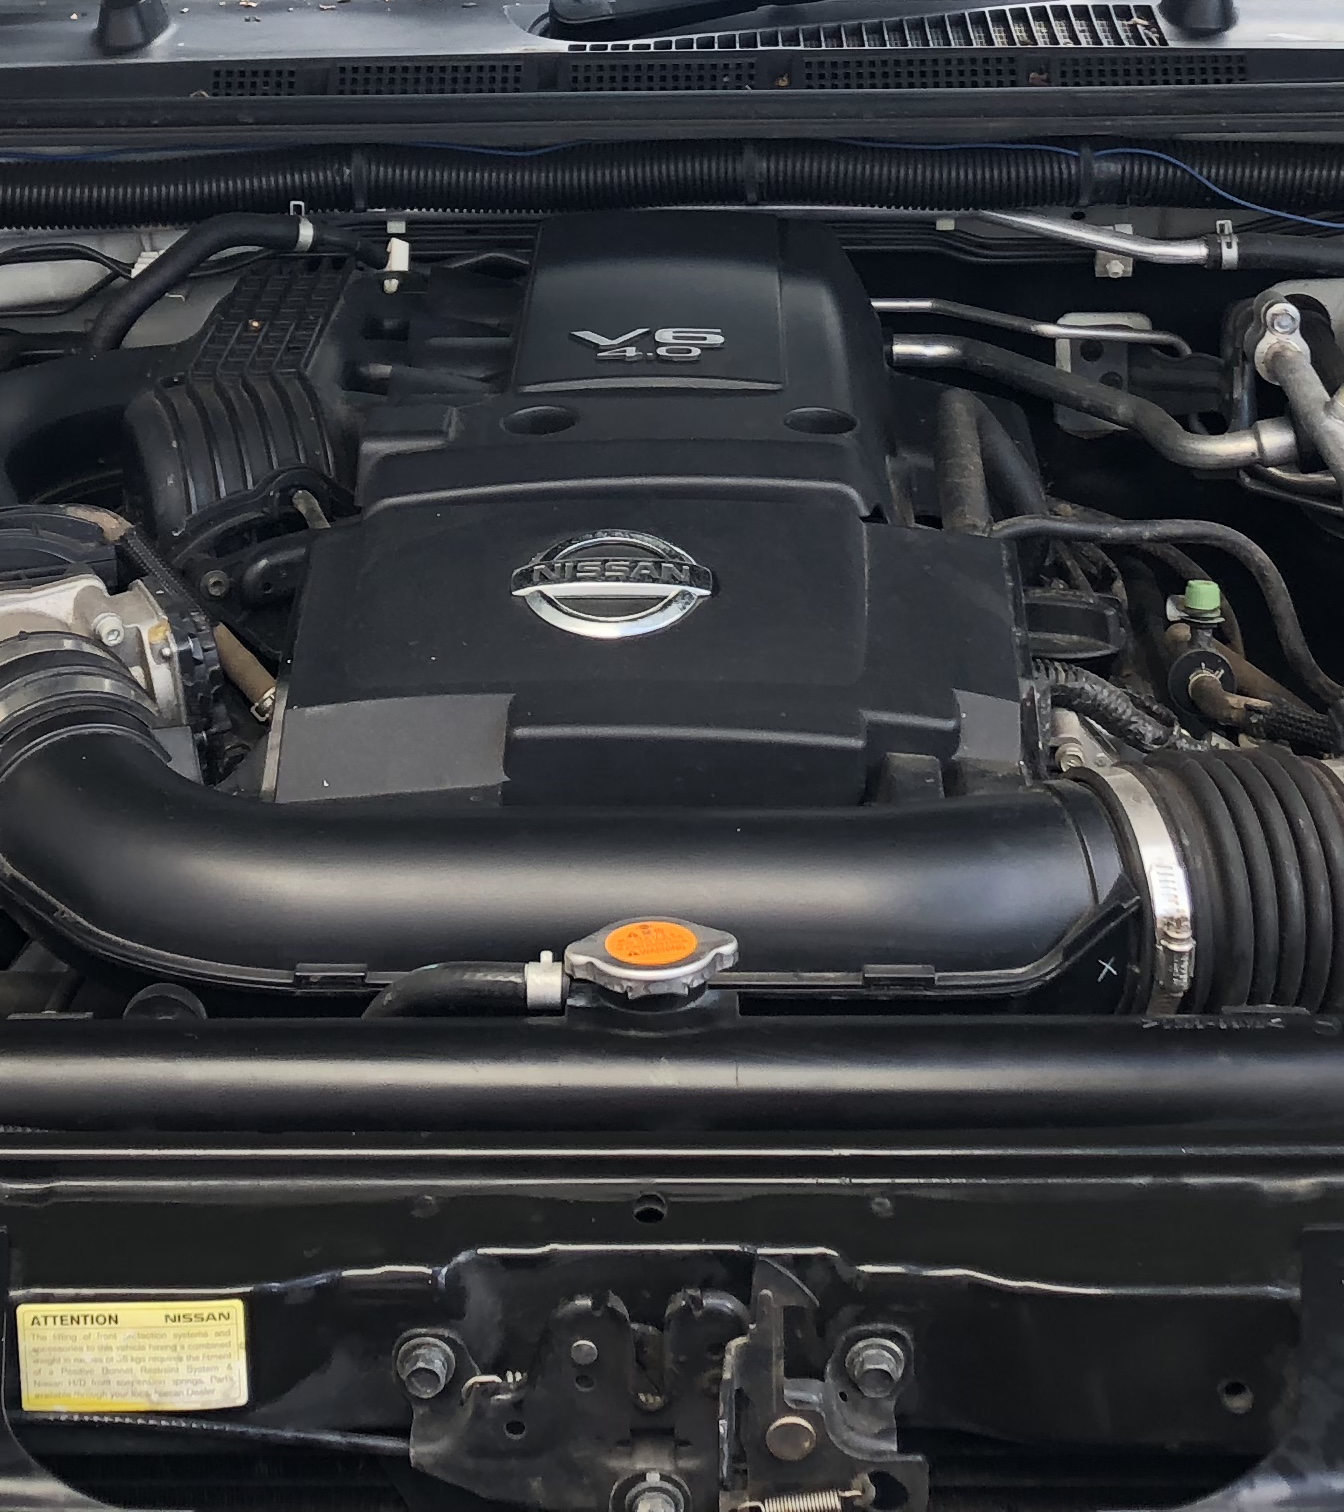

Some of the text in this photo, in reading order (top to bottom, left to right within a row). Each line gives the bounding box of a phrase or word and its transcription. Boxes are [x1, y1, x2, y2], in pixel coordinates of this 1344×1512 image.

[569, 327, 725, 347] V6
[596, 346, 702, 361] 4.0
[532, 560, 691, 584] NISSAN
[31, 1313, 119, 1326] ATTENTION
[164, 1311, 231, 1323] NISSAN
[31, 1333, 47, 1341] The
[82, 1332, 91, 1341] of
[97, 1331, 117, 1340] front
[214, 1328, 231, 1337] and
[187, 1341, 231, 1349] combined
[186, 1353, 200, 1361] the
[32, 1368, 42, 1376] of
[186, 1364, 219, 1376] System
[68, 1378, 87, 1387] H/D
